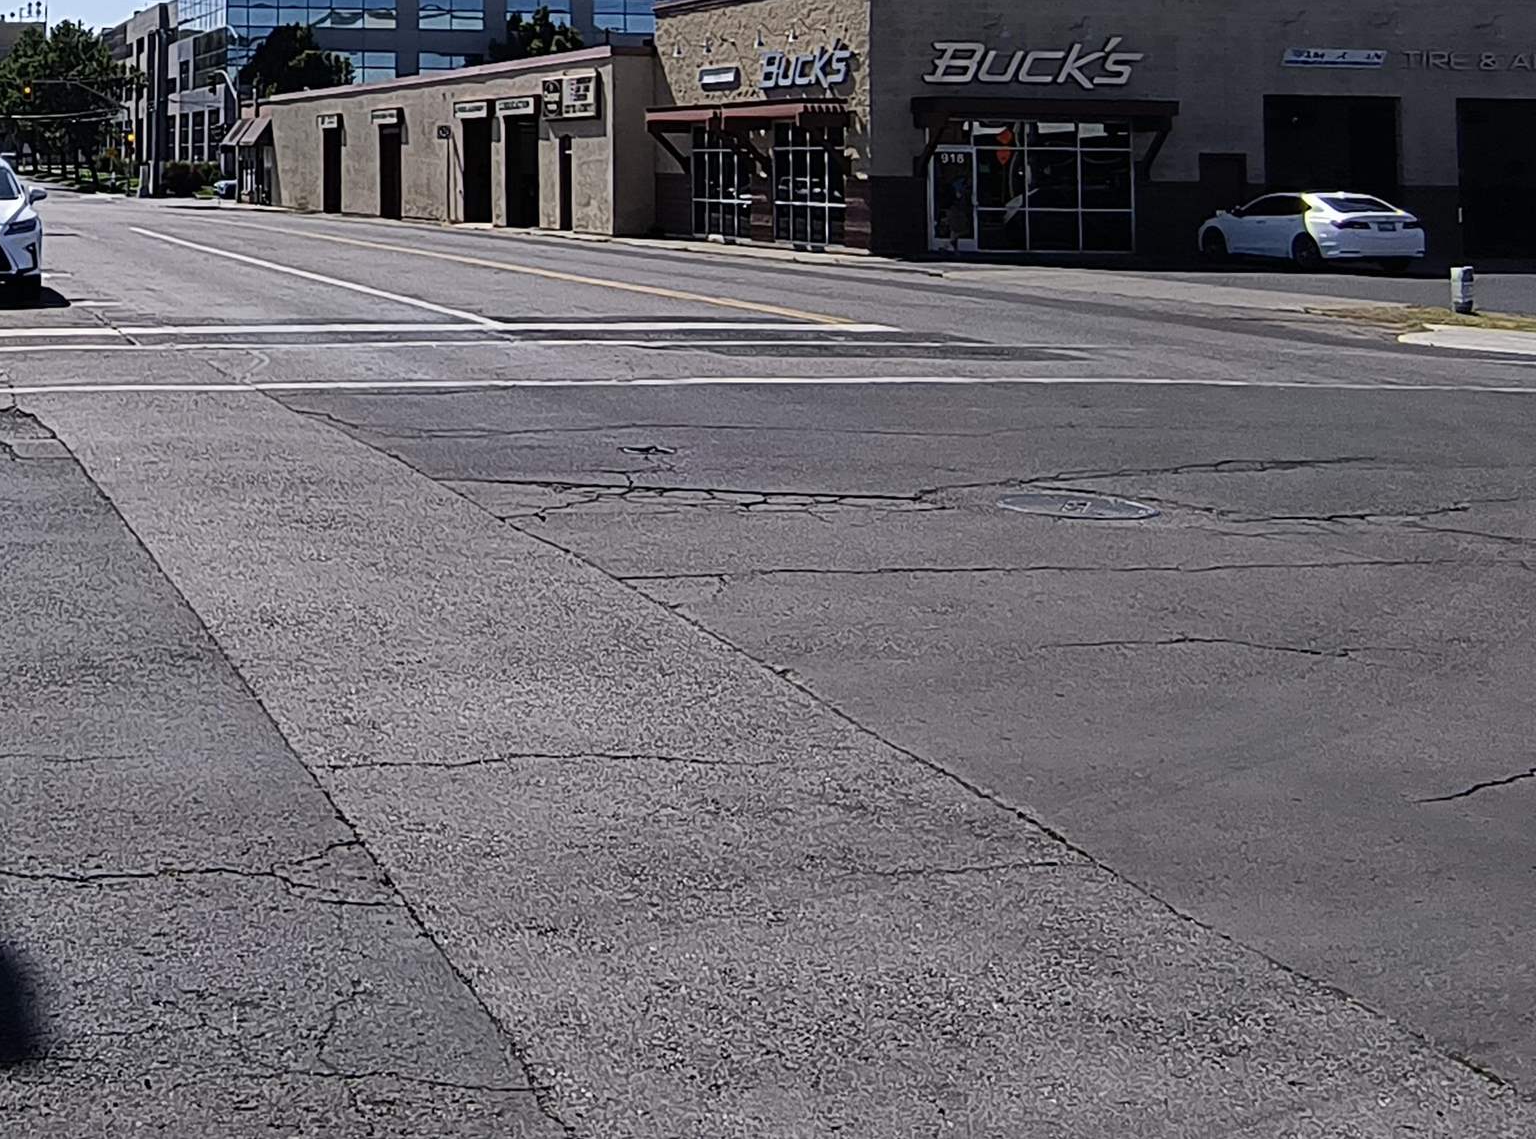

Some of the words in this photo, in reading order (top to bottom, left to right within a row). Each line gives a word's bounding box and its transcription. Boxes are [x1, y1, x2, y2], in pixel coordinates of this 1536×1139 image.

[922, 36, 1145, 90] BUCK'S
[1401, 49, 1473, 71] TIRE
[1479, 52, 1497, 71] &
[1509, 52, 1536, 71] A
